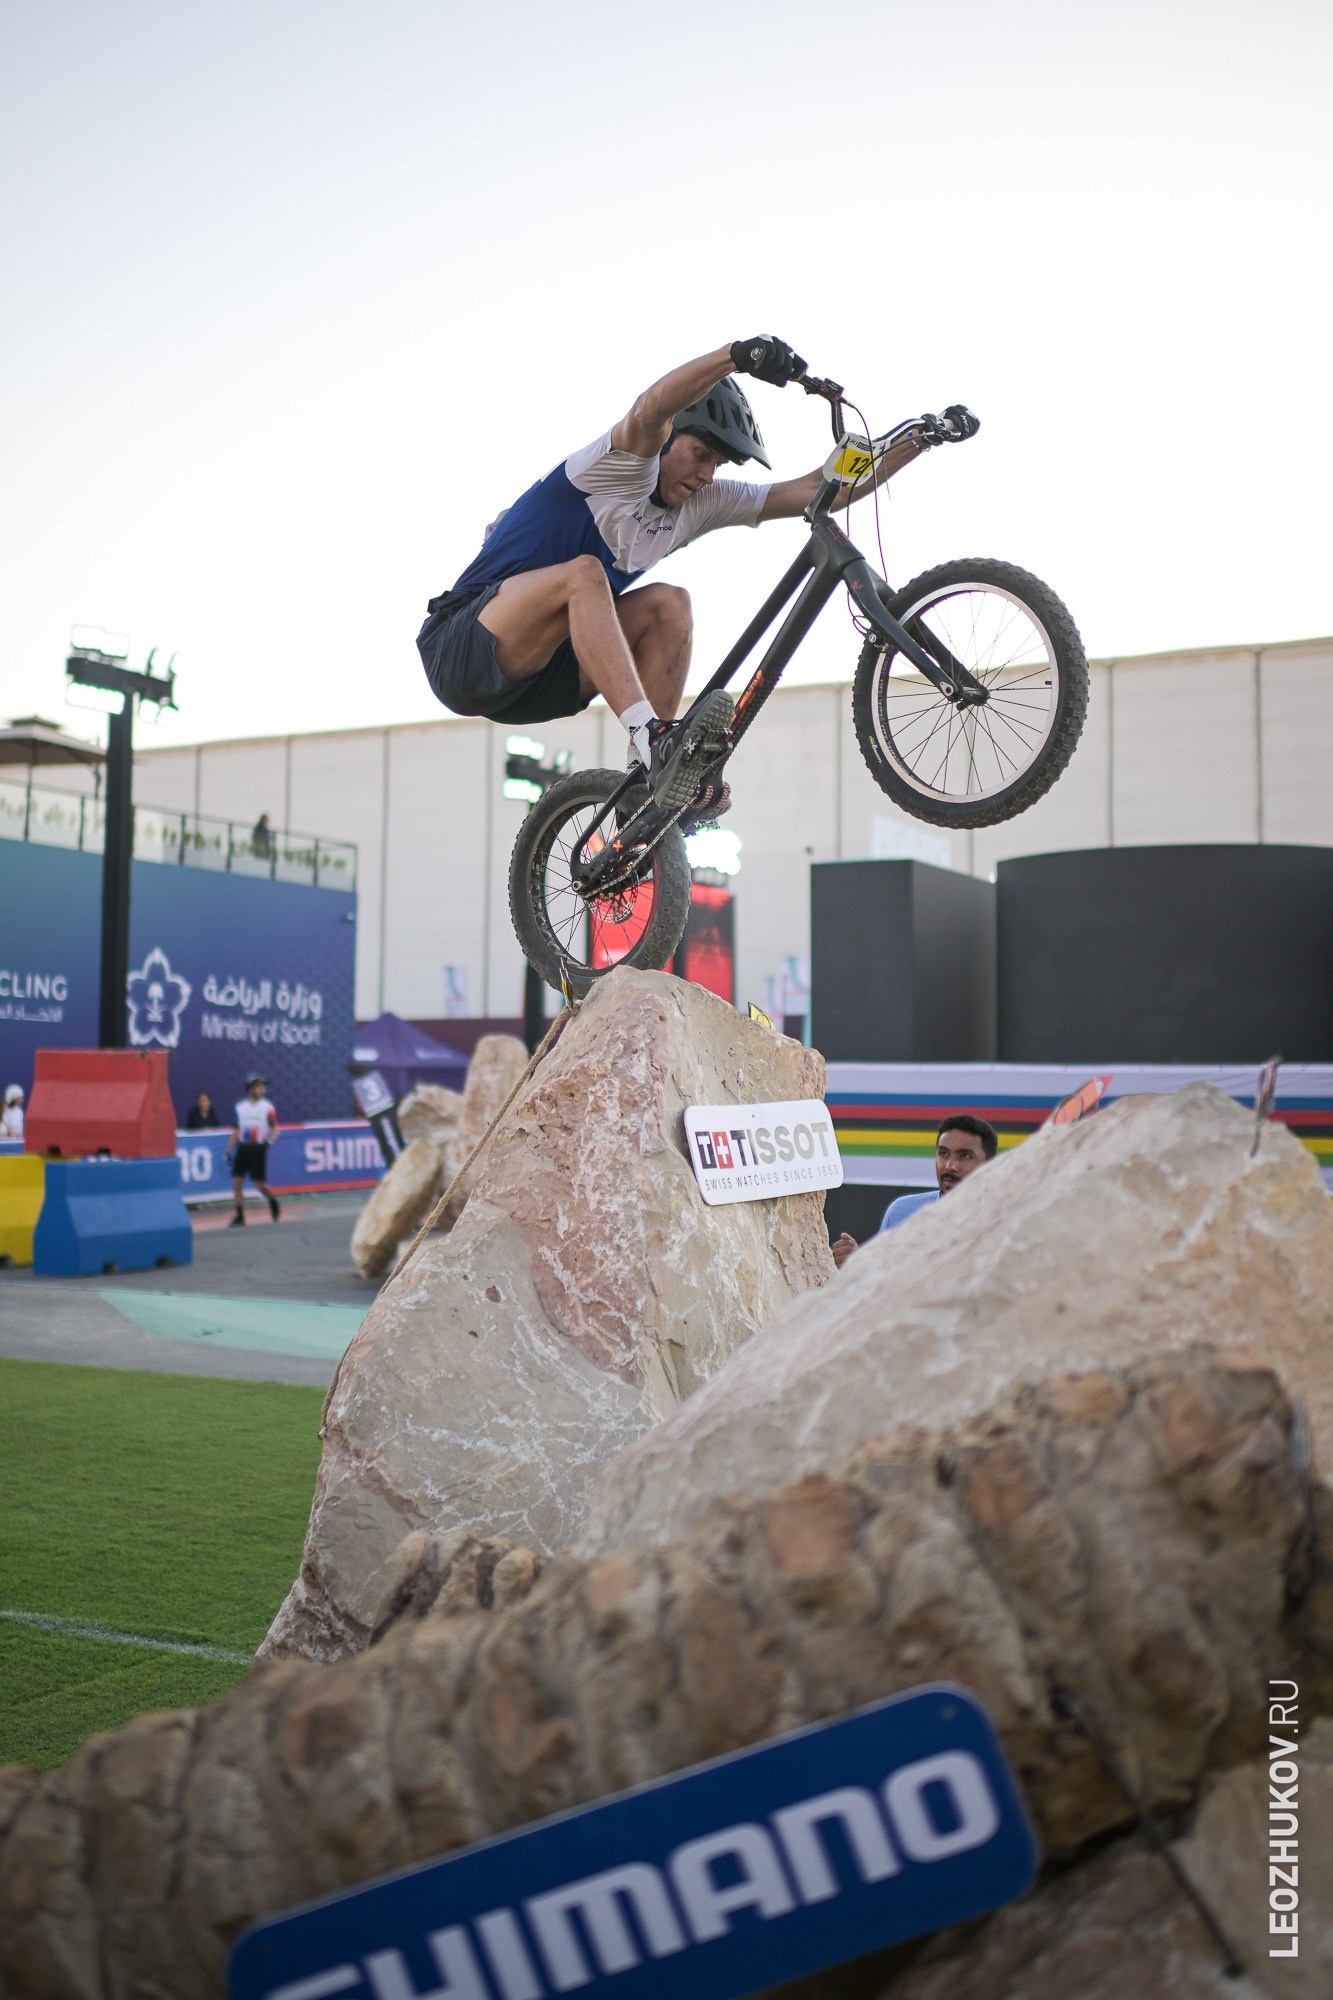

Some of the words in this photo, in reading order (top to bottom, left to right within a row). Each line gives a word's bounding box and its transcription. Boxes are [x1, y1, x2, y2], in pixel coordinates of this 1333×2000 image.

[848, 457, 870, 474] 12
[0, 971, 68, 1001] CLING
[202, 1014, 259, 1046] Ministry
[261, 1019, 279, 1042] of
[280, 1018, 321, 1047] Sport
[304, 1137, 385, 1172] SHIM
[730, 1122, 829, 1167] TISSOT
[704, 1177, 733, 1191] SWISS
[736, 1173, 779, 1188] WATCHES
[783, 1167, 814, 1182] SINCE
[817, 1164, 839, 1177] 1853
